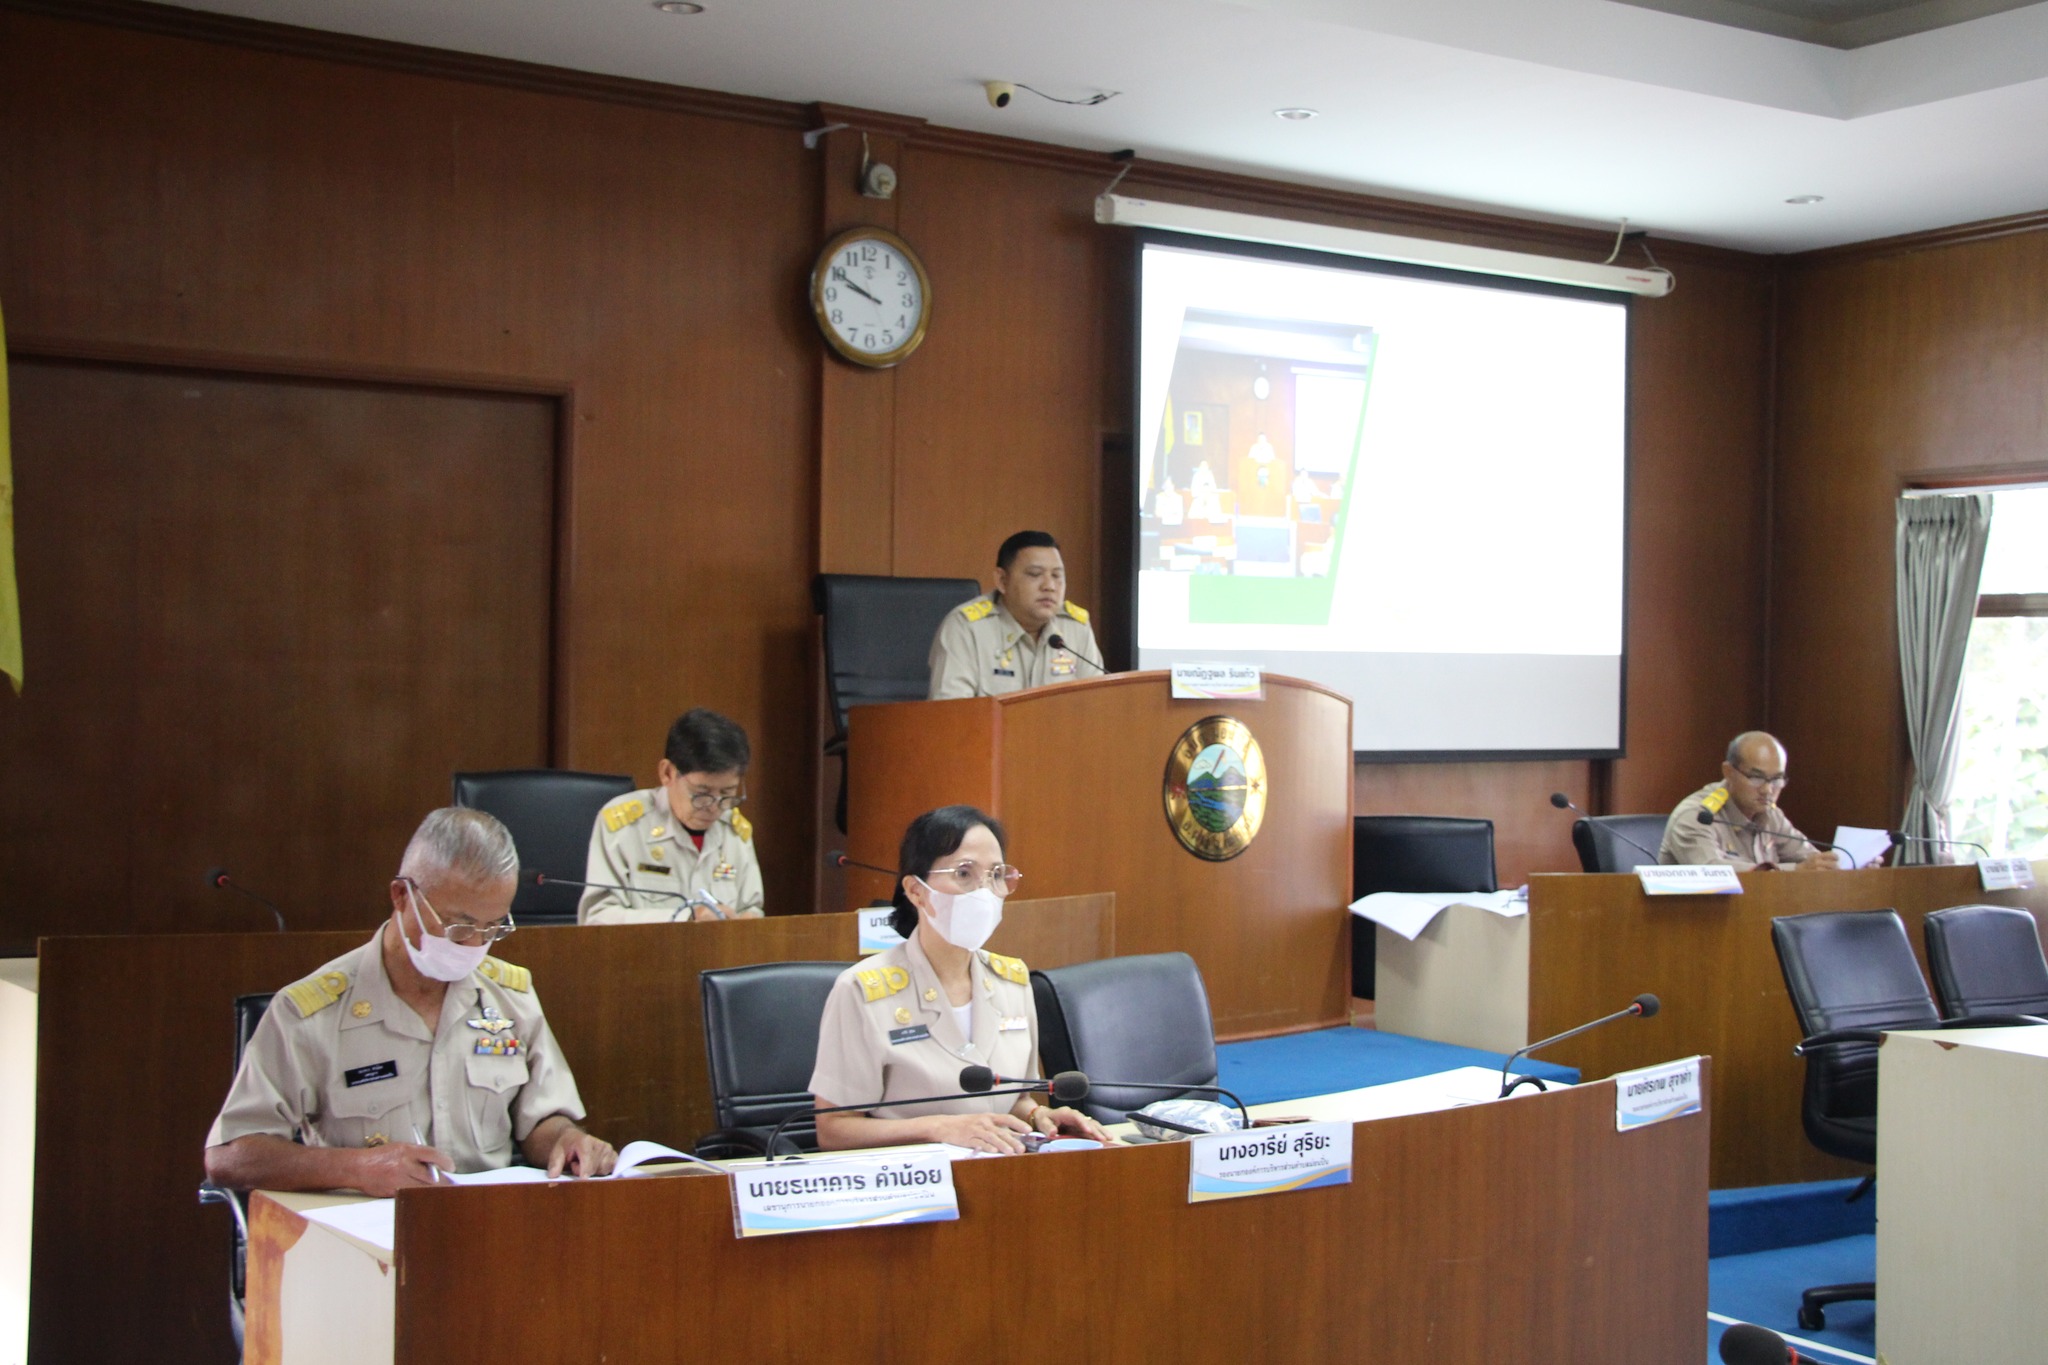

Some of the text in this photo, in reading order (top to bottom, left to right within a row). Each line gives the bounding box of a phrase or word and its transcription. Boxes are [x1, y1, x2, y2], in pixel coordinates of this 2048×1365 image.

[846, 251, 859, 267] 11
[861, 245, 877, 262] 12
[884, 254, 891, 270] 1
[832, 266, 846, 282] 10
[897, 271, 907, 286] 2
[825, 287, 837, 302] 9
[902, 293, 913, 308] 3
[831, 309, 843, 324] 8
[895, 314, 906, 329] 4
[848, 327, 858, 343] 7
[864, 333, 876, 349] 6
[881, 329, 893, 345] 5
[1219, 1132, 1331, 1161] นางอารีย์ สุริยะ
[749, 1164, 942, 1199] นายธนาคาร คำน้อย
